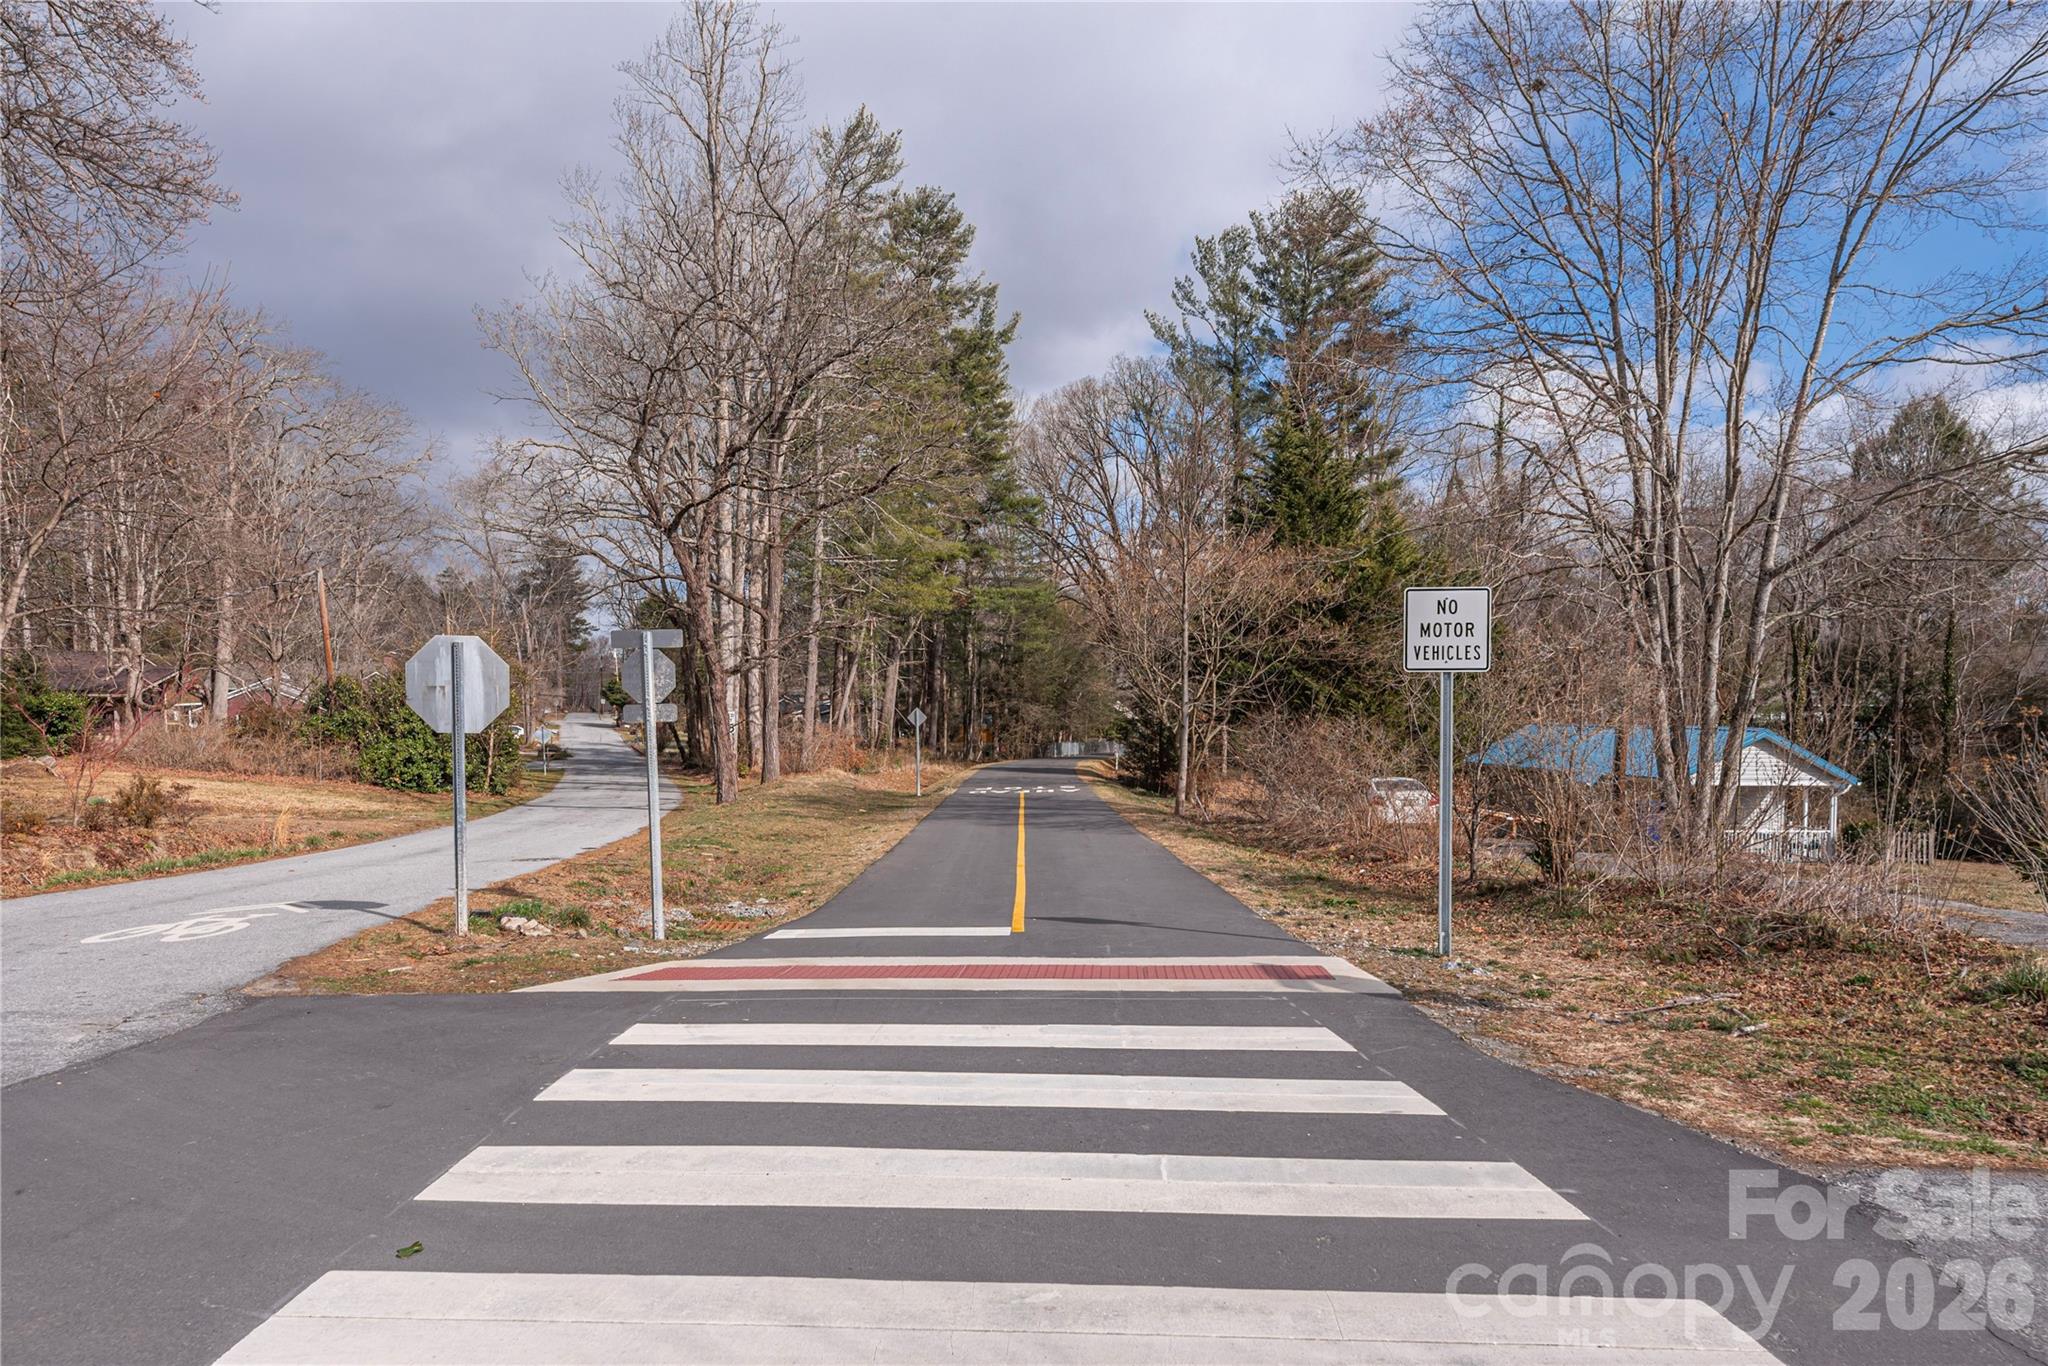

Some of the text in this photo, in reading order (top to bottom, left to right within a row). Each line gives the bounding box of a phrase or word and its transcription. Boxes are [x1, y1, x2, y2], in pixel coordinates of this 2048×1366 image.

[1436, 599, 1458, 615] NO
[1420, 622, 1475, 638] MOTOR
[1414, 645, 1481, 660] VEHICLES
